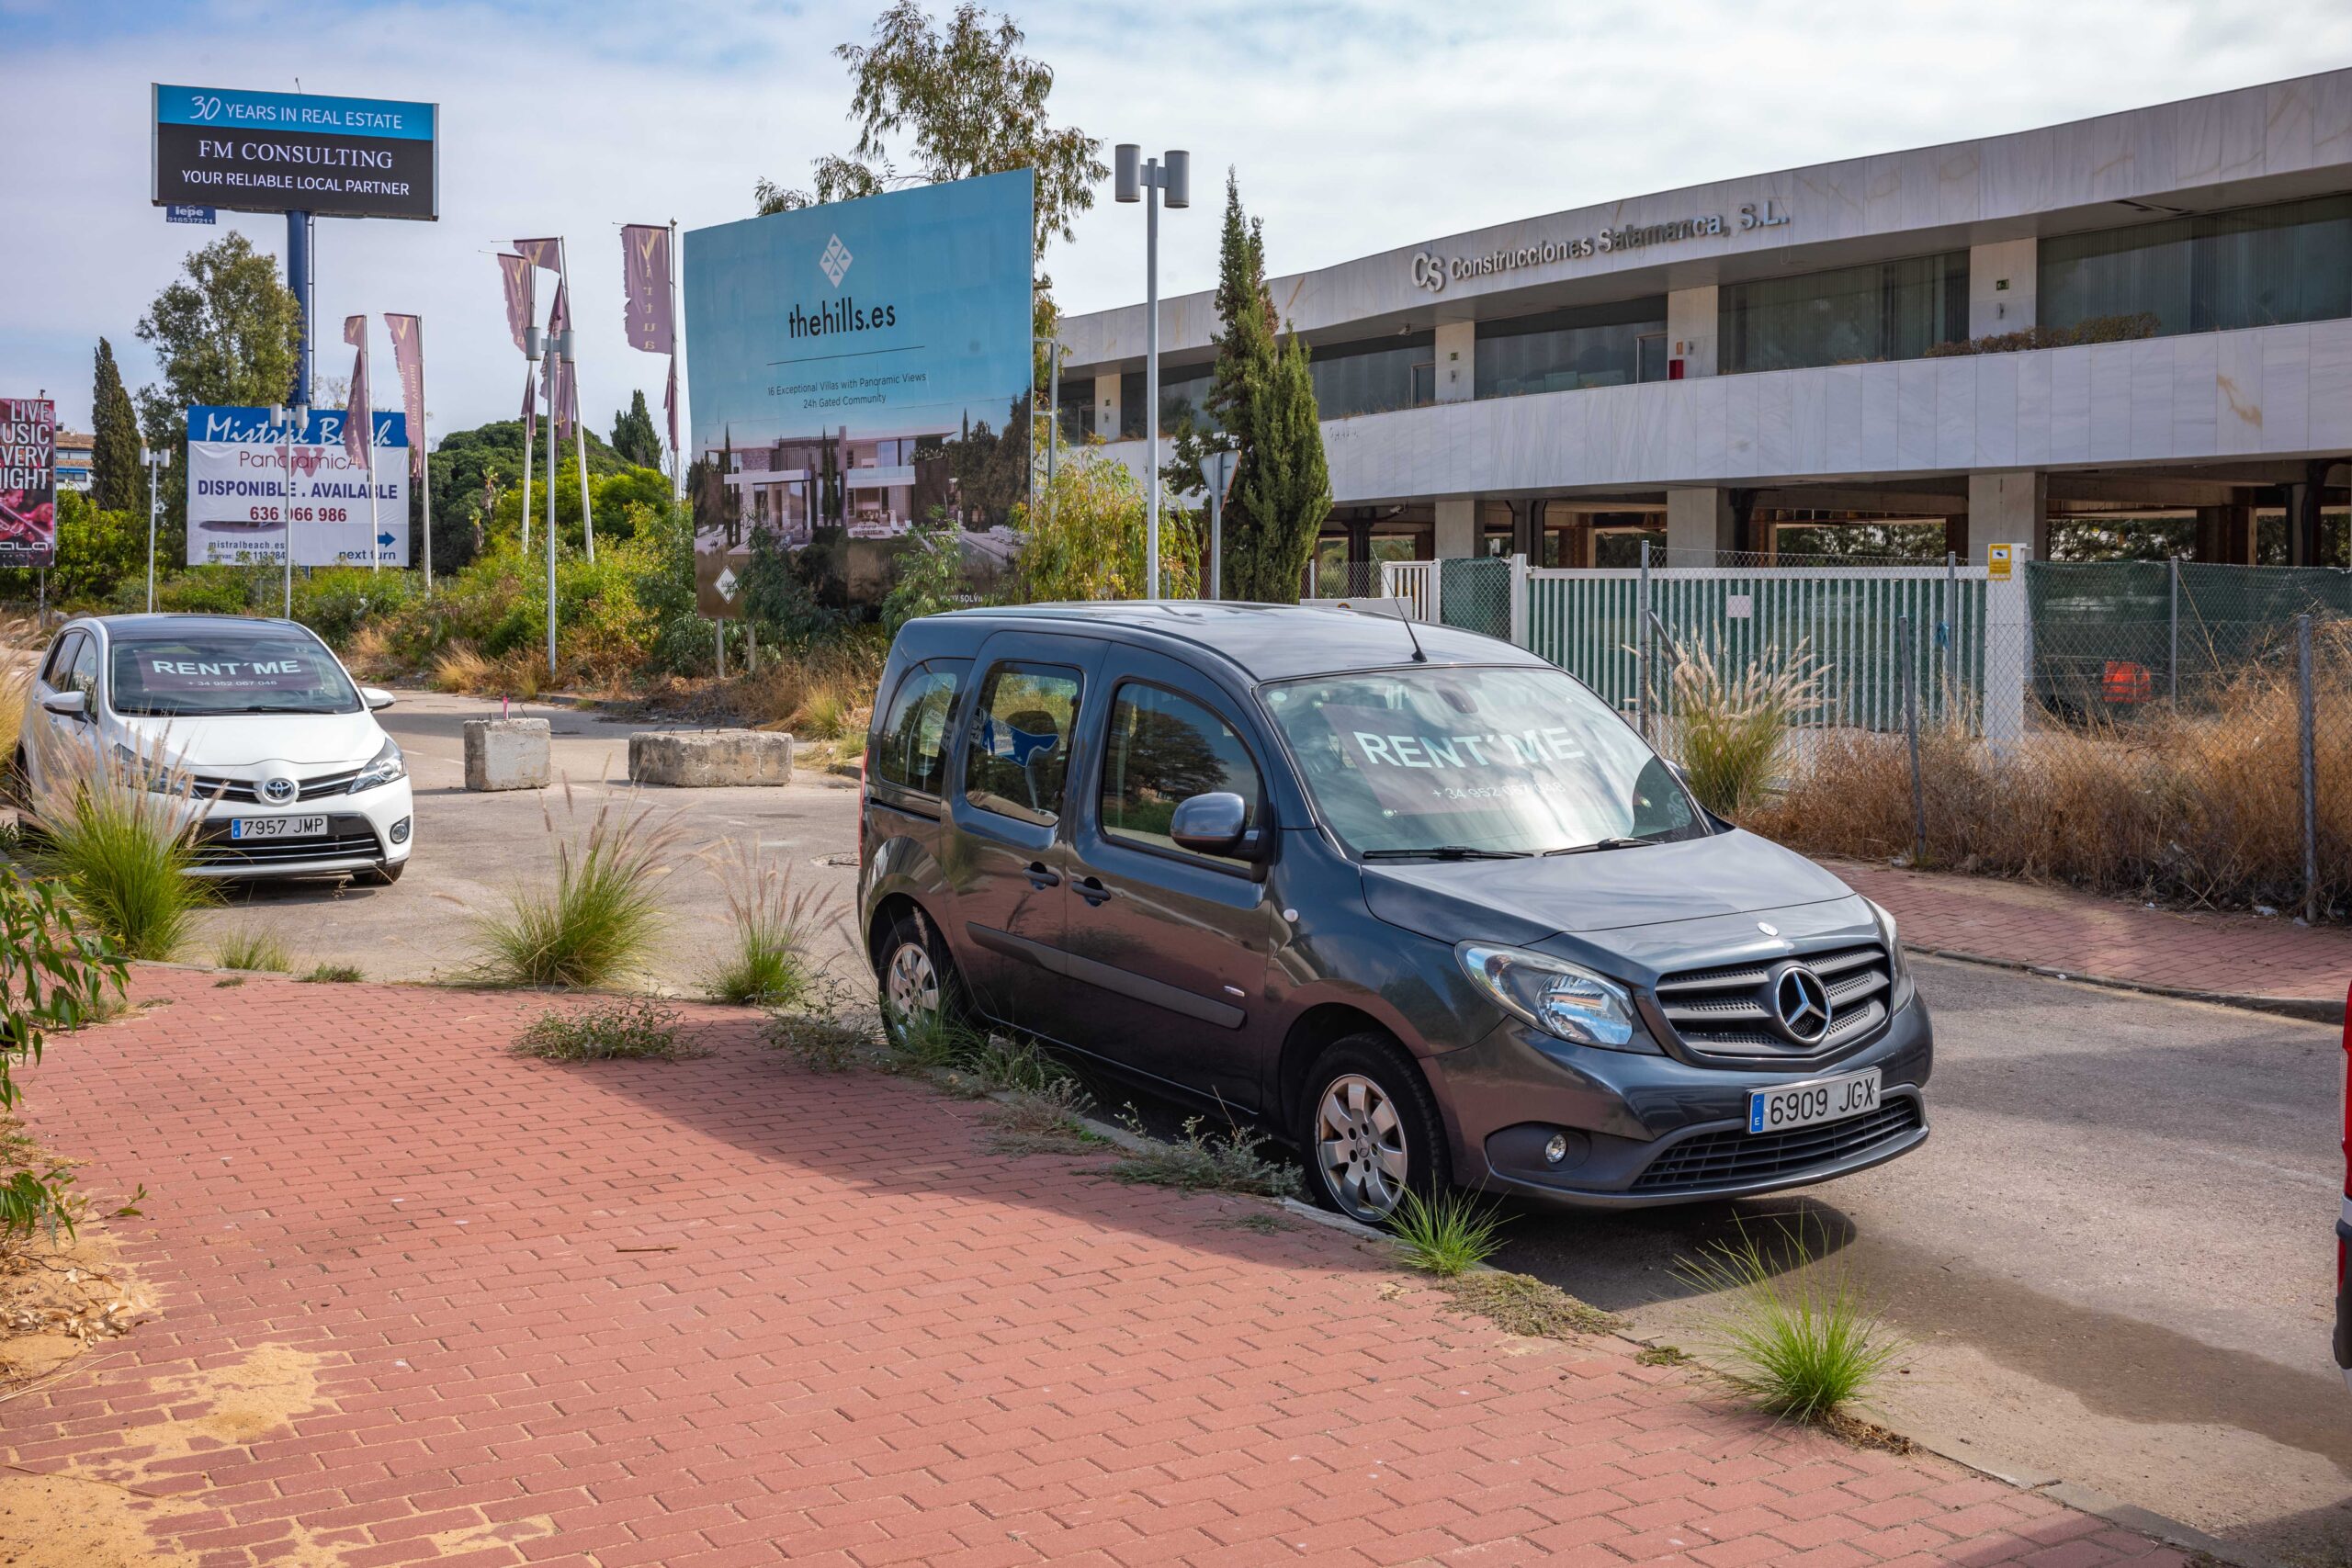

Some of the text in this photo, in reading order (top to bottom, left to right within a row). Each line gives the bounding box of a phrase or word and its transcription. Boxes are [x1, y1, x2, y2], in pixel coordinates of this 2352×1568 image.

[189, 96, 402, 130] 30 YEARS IN REAL ESTATE
[198, 140, 393, 169] FM CONSULTING
[182, 170, 410, 196] YOUR RELIABLE LOCAL PARTNER
[1410, 200, 1790, 293] CS Construcciones Salamanca, S.L.
[789, 297, 896, 338] thehills.es
[767, 373, 926, 396] 16 Exceptional Villas with Panoramic Views
[11, 400, 50, 423] LIVE
[803, 393, 887, 409] 24h Gated Community
[0, 423, 50, 445] USIC
[0, 445, 50, 467] VERY
[198, 479, 296, 497] DISPONIBLE
[250, 506, 279, 521] 636
[318, 508, 347, 522] 986
[208, 541, 285, 549] mistralbeach.es
[339, 550, 367, 560] next
[1444, 787, 1466, 799] 34
[1468, 786, 1500, 798] 952
[244, 818, 323, 836] 7957 JMP
[1770, 1077, 1875, 1125] 6909 JGX
[1754, 1117, 1760, 1126] E
